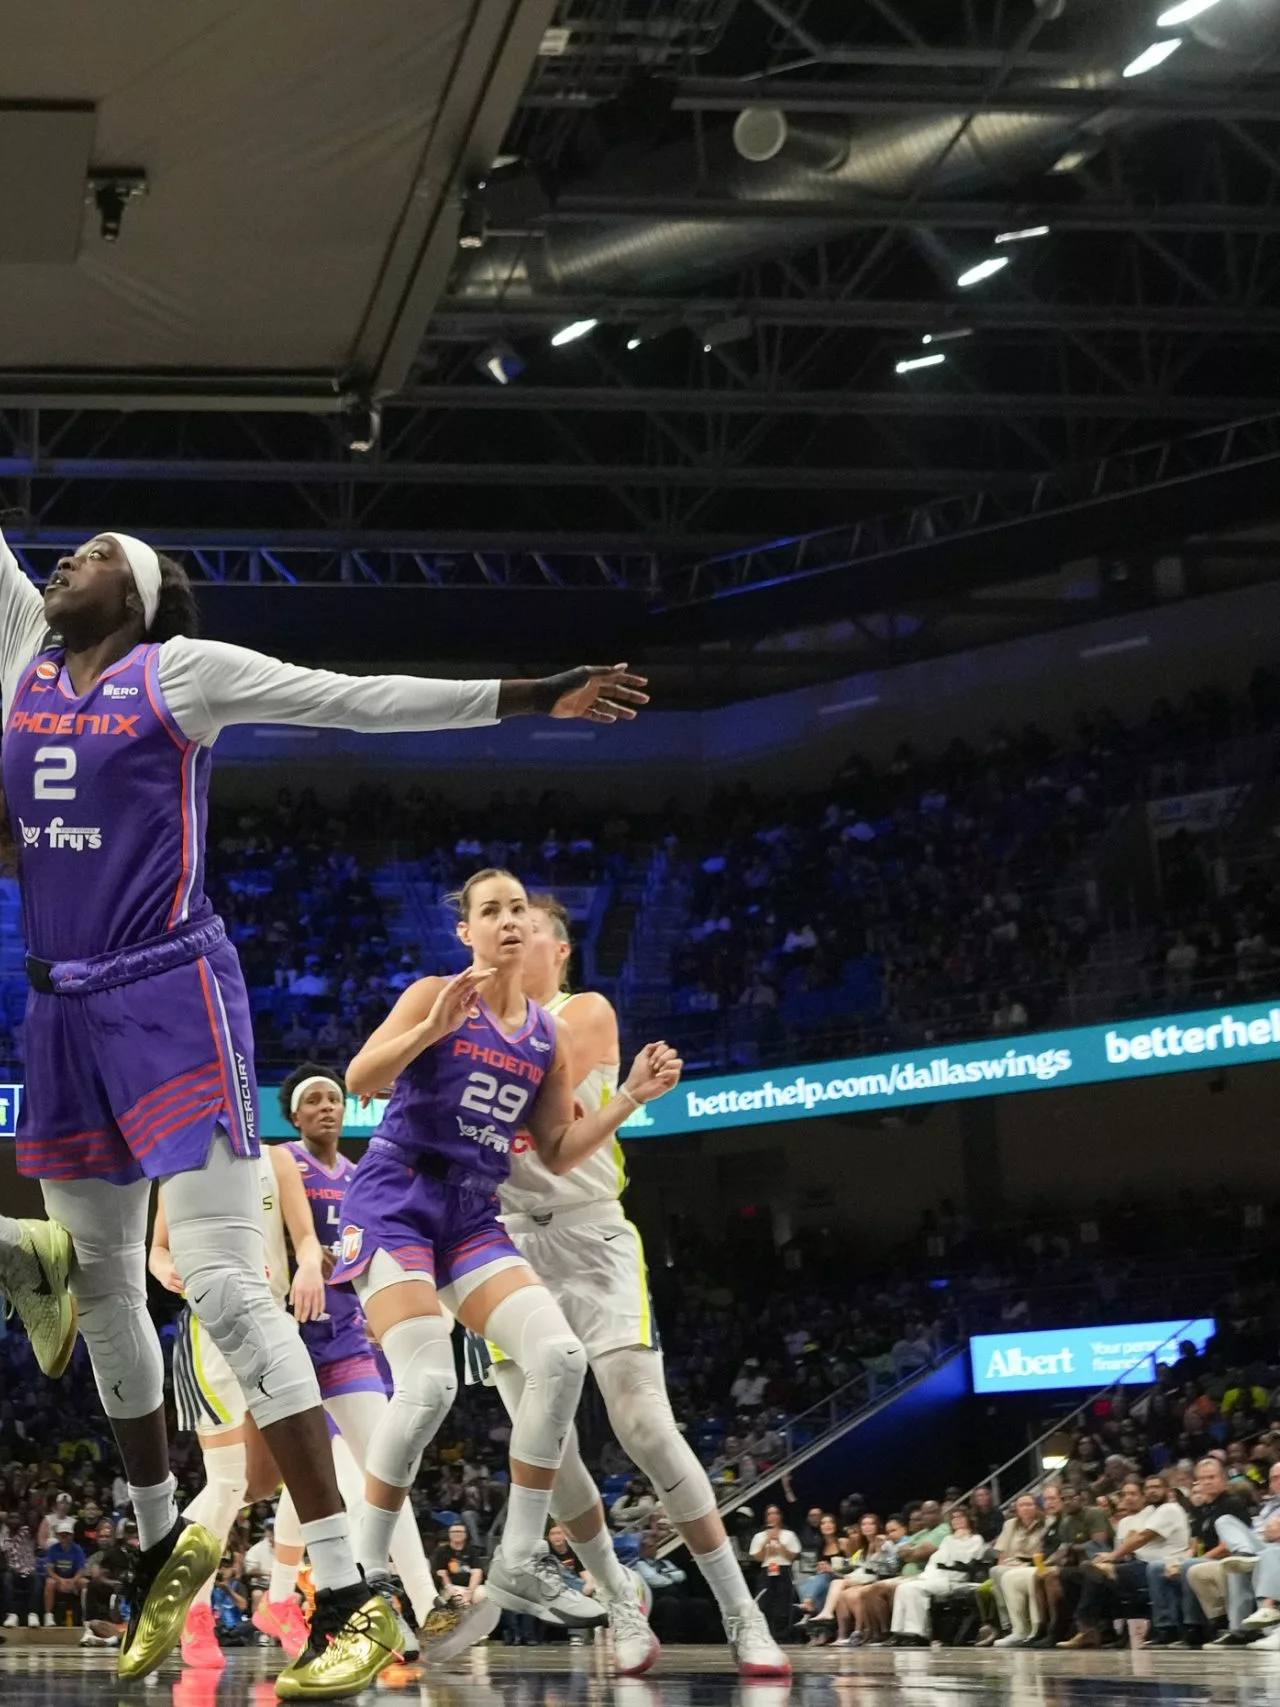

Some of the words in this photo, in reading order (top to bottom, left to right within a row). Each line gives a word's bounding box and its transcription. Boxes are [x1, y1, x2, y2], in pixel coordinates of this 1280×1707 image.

[11, 711, 141, 737] PHOENIX
[34, 746, 77, 800] 2
[44, 816, 102, 851] fry's
[235, 1053, 255, 1138] MERCURY
[460, 1072, 528, 1123] 29
[687, 1049, 1072, 1118] betterhelp.com/dallaswings
[985, 1347, 1075, 1378] Albert
